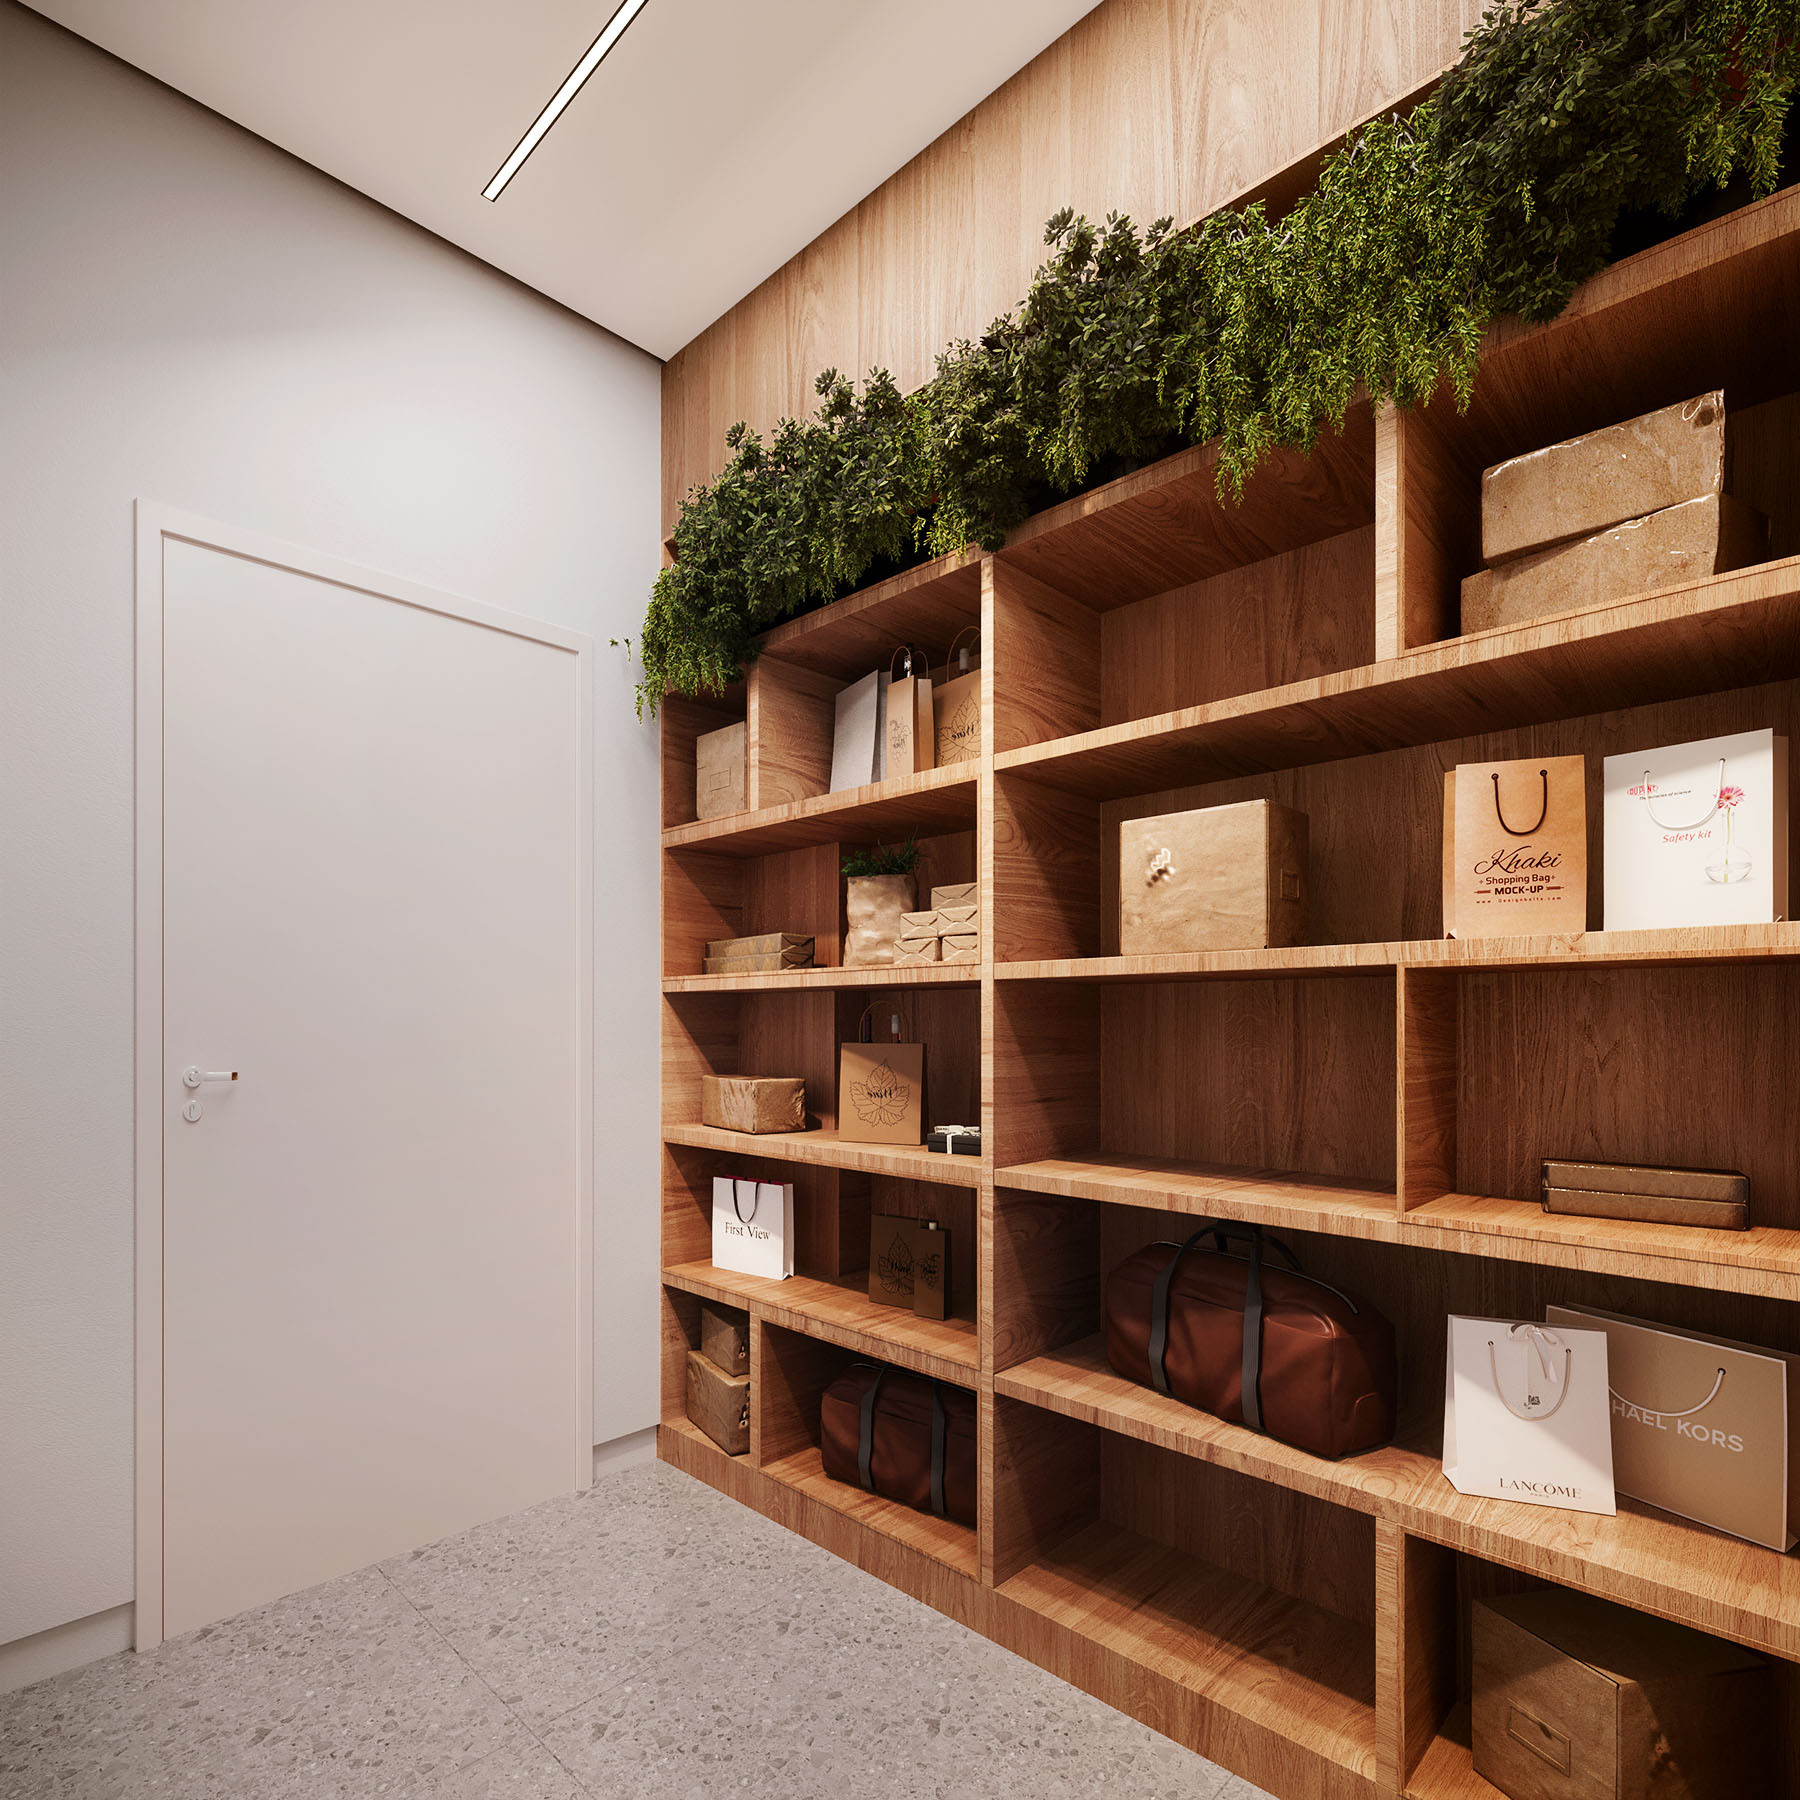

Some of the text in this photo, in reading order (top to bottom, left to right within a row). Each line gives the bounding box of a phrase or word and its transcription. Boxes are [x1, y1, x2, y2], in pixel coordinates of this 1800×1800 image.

[1629, 784, 1656, 796] DUPNT
[1663, 832, 1696, 844] Safety
[1473, 845, 1562, 875] Khaki
[1485, 873, 1551, 886] Shopping Bag
[1494, 885, 1544, 895] MOCK-UP
[725, 1221, 771, 1240] First View
[1676, 1418, 1744, 1453] KORS
